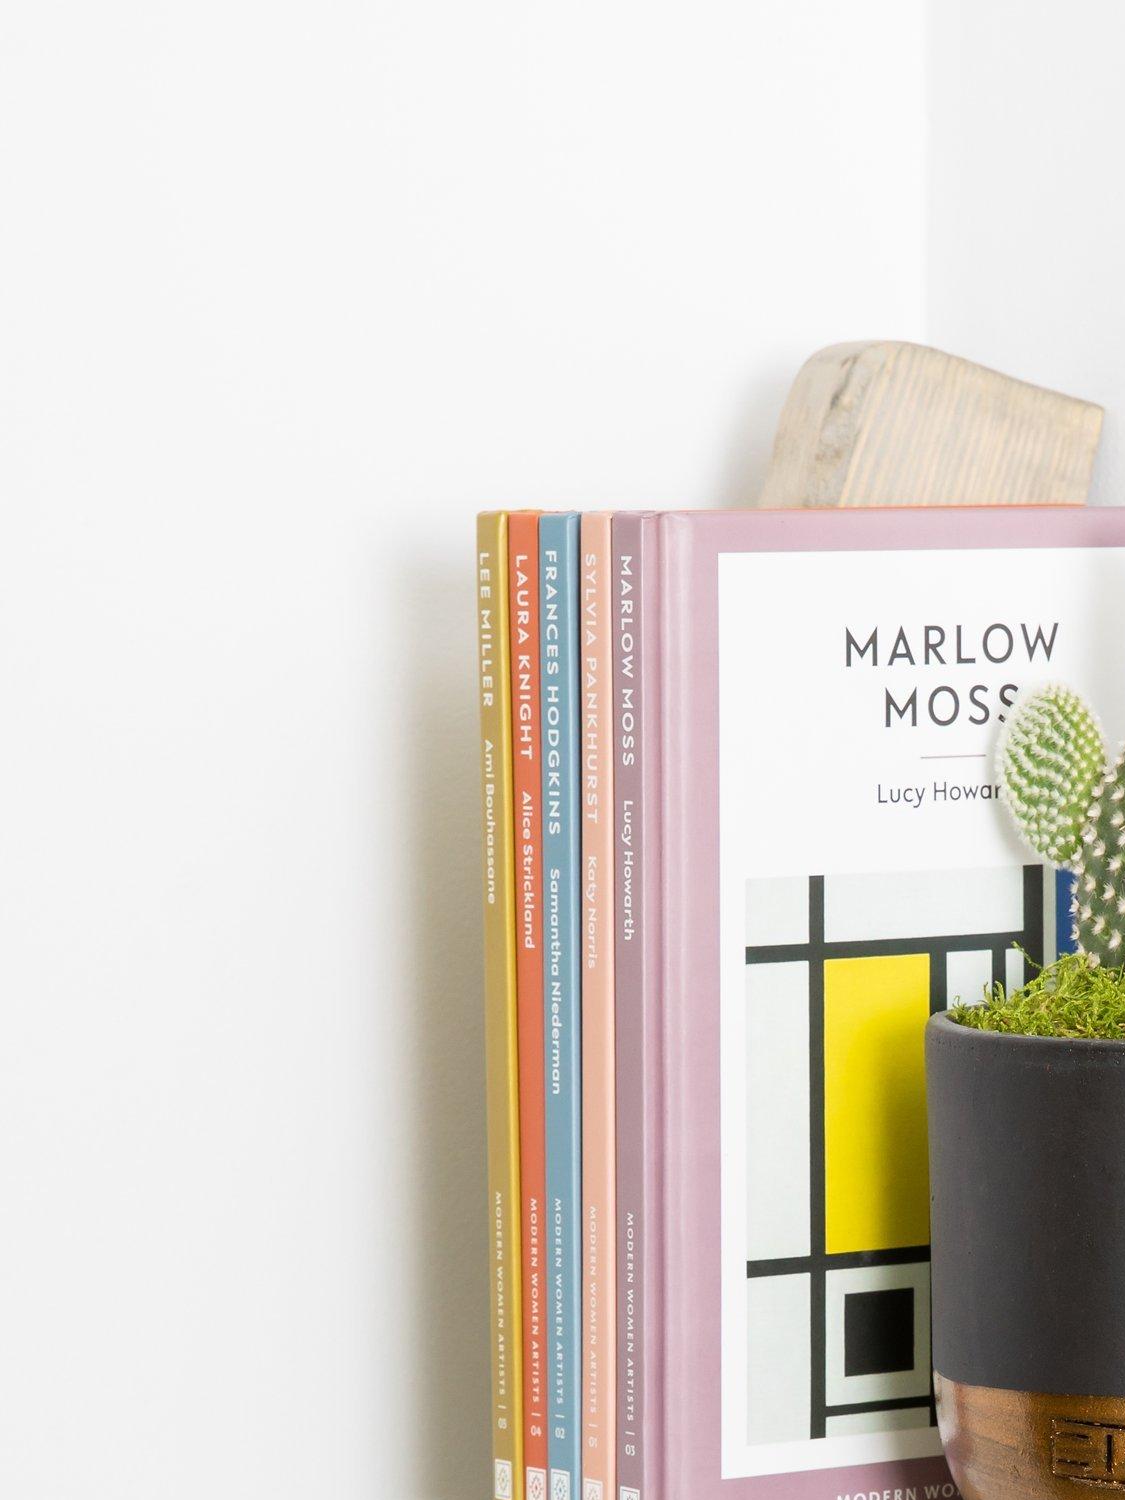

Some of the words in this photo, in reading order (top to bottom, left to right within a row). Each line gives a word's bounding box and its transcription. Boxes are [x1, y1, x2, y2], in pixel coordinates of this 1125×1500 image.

[479, 552, 491, 599] LEE
[515, 554, 530, 645] LAURA
[585, 553, 597, 646] SYLVIA
[545, 550, 559, 675] FRANCES
[620, 555, 634, 679] MARLOW
[845, 622, 1059, 667] MARLOW
[481, 609, 494, 707] MILLER
[518, 655, 533, 760] KNIGHT
[621, 688, 635, 766] MOSS
[884, 683, 1019, 728] MOSS
[547, 686, 561, 835] HODGKINS
[586, 657, 598, 824] PANKHURST
[521, 790, 533, 840] Alice
[621, 800, 634, 847] Lucy
[877, 783, 926, 808] Lucy
[933, 781, 1002, 802] Howar
[522, 844, 536, 949] Strickland
[585, 855, 598, 904] Katy
[623, 851, 635, 941] Howarth
[550, 868, 562, 976] Samantha
[587, 908, 598, 969] Norris
[551, 981, 563, 1095] Niederman
[495, 1191, 503, 1261] MODERN
[530, 1198, 539, 1267] MODERN
[554, 1198, 563, 1268] MODERN
[589, 1205, 597, 1276] MODERN
[626, 1212, 635, 1283] MODERN
[496, 1266, 504, 1329] WOMEN
[531, 1273, 539, 1335] WOMEN
[555, 1273, 563, 1337] WOMEN
[589, 1282, 597, 1345] WOMEN
[626, 1289, 635, 1353] WOMEN
[531, 1340, 540, 1403] ARTISTS
[556, 1342, 564, 1405] ARTISTS
[626, 1358, 635, 1422] ARTISTS
[923, 1482, 960, 1500] WO
